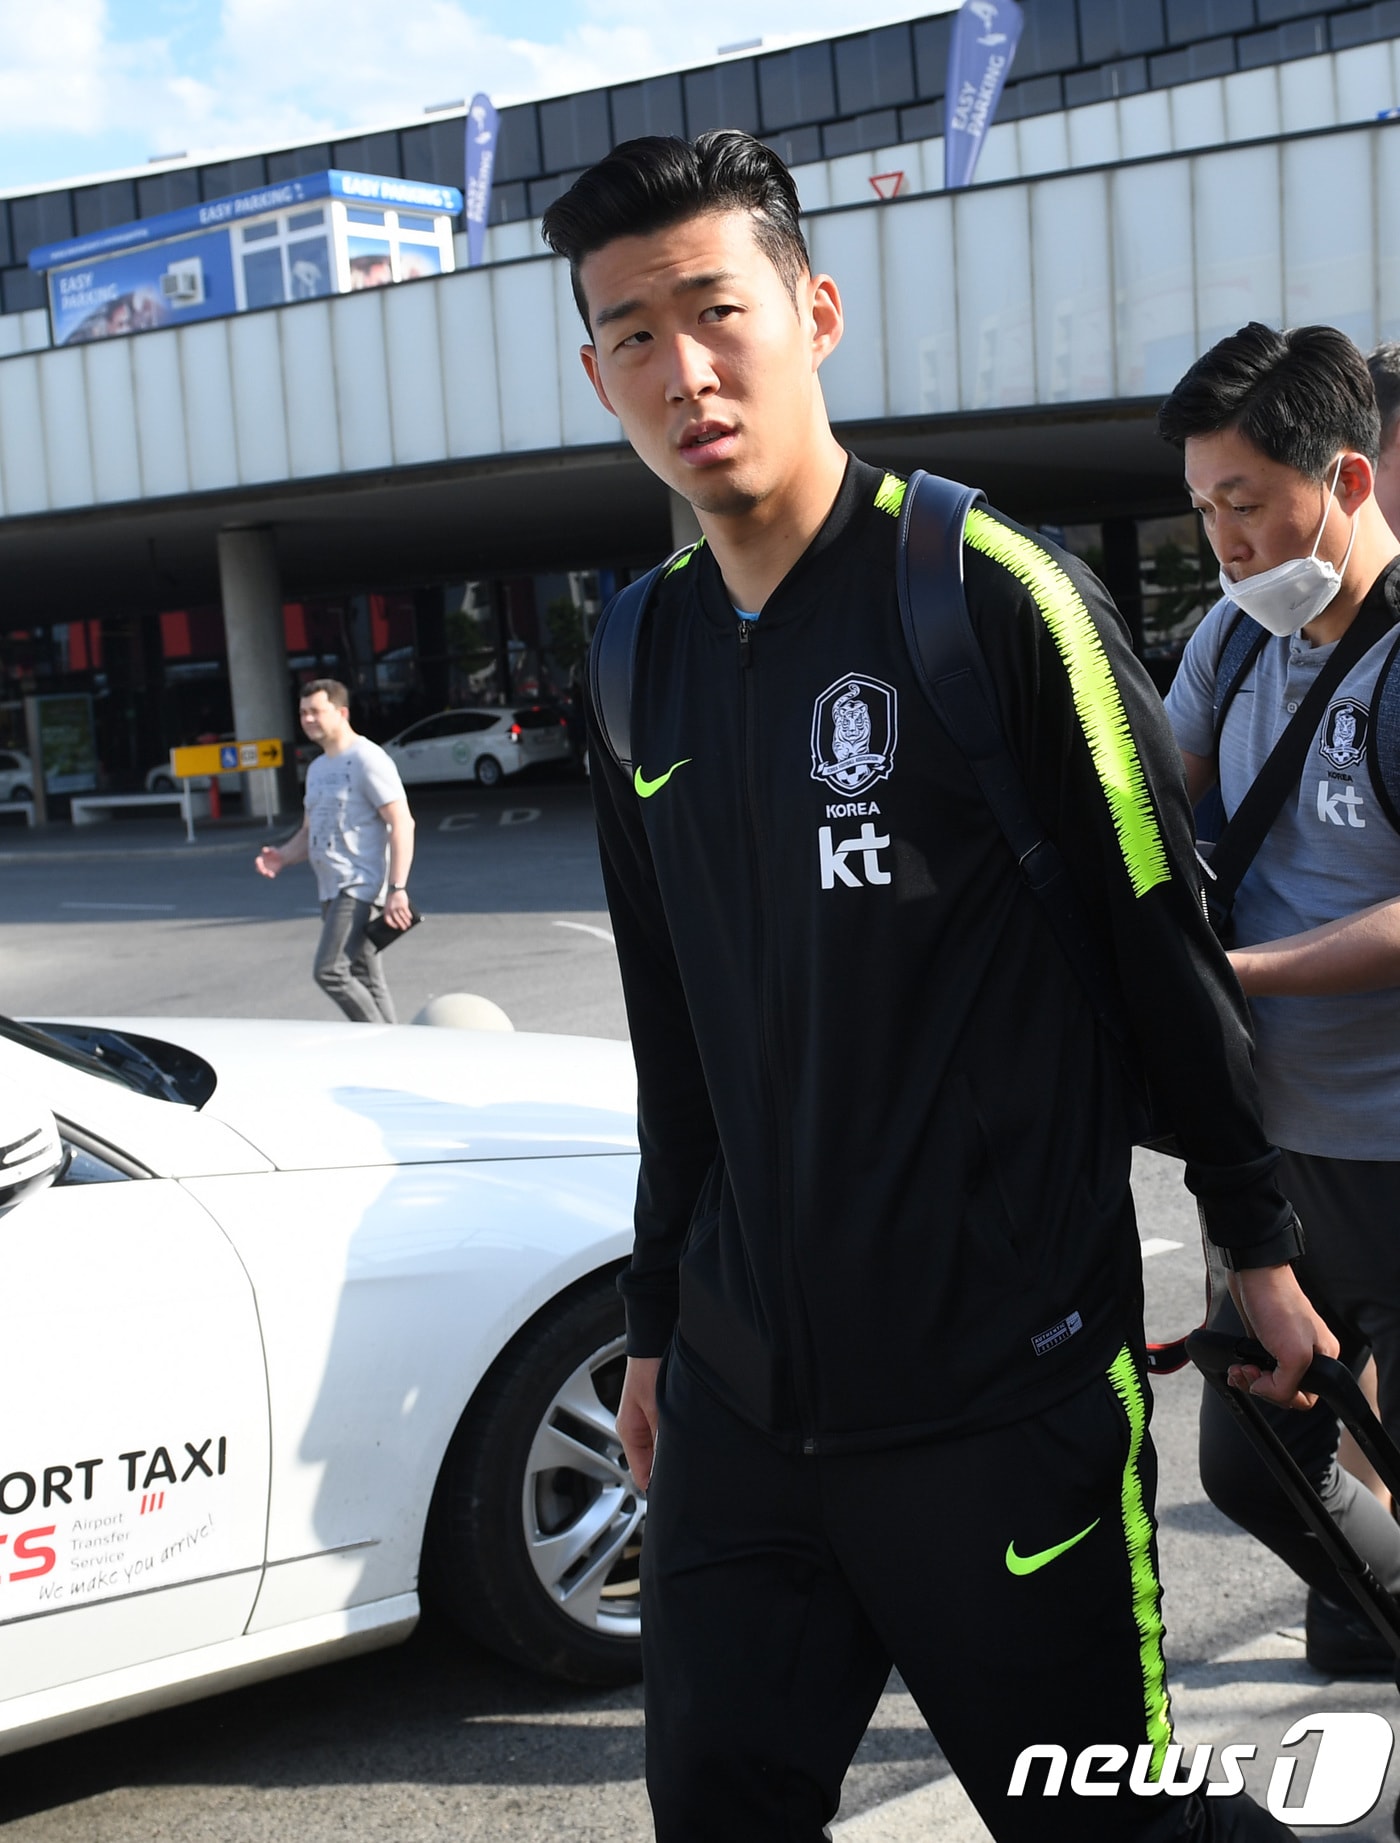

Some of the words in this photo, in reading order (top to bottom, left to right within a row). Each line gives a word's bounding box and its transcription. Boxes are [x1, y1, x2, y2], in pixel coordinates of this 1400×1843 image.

[951, 81, 978, 131] EASY
[967, 54, 1005, 136] PARKING
[200, 203, 233, 225] EASY
[234, 186, 293, 214] PARKING
[342, 176, 379, 198] EASY
[381, 182, 443, 207] PARKING
[60, 272, 94, 295] EASY
[826, 801, 881, 818] KOREA
[1317, 780, 1366, 828] kt
[818, 823, 892, 890] kt
[118, 1436, 227, 1492] TAXI
[71, 1531, 131, 1551] Transfer
[72, 1513, 124, 1532] Airport
[39, 1583, 64, 1601] We
[71, 1570, 119, 1596] make
[124, 1556, 154, 1585] you
[70, 1552, 125, 1571] Service
